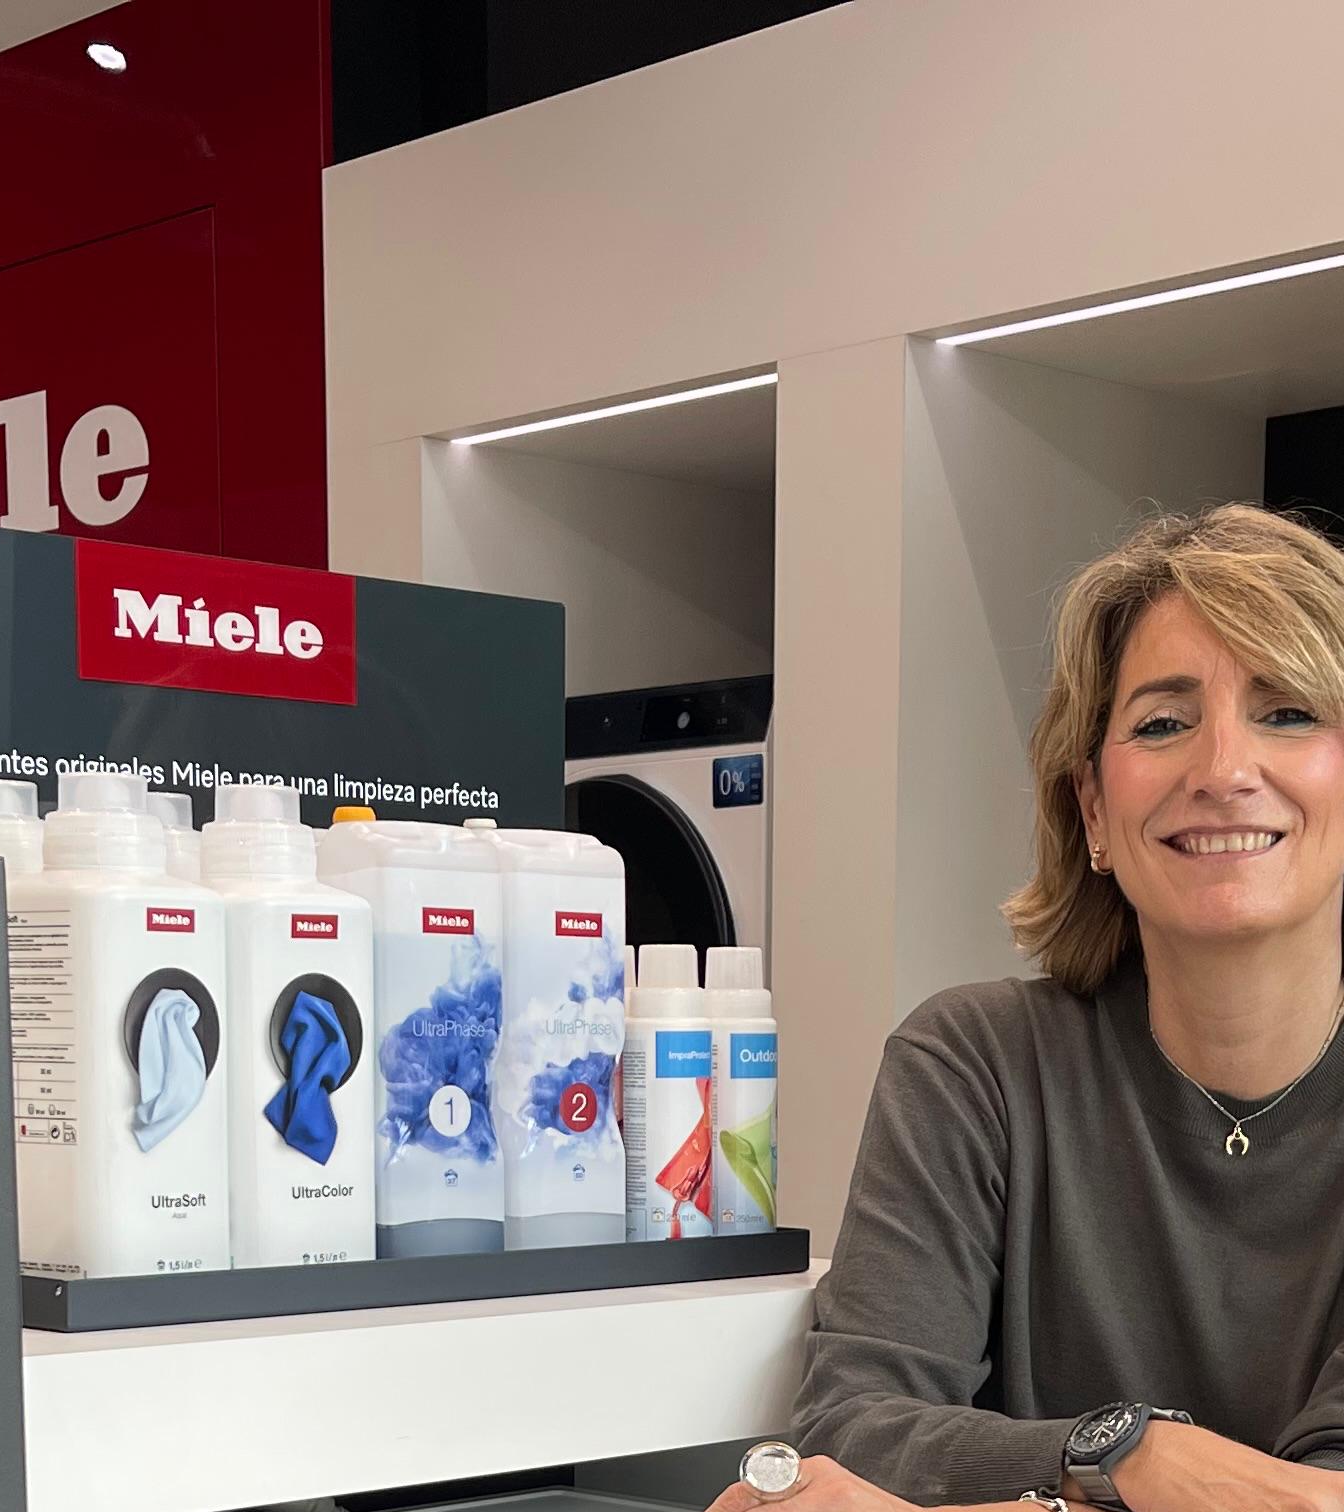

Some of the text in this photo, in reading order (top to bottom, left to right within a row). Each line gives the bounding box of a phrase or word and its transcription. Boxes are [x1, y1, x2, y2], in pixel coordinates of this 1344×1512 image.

[113, 587, 324, 660] Miele
[172, 760, 233, 788] Miele
[291, 776, 328, 797] una
[333, 773, 415, 805] limpieza
[420, 783, 500, 809] perfecta
[719, 768, 745, 795] 0%
[152, 913, 191, 926] Miele
[296, 921, 333, 933] Miele
[428, 915, 469, 928] Miele
[560, 918, 598, 931] Miele
[412, 1019, 486, 1038] UltraPhase
[545, 1019, 612, 1037] UltraPhase
[444, 1097, 455, 1126] 1
[571, 1092, 587, 1122] 2
[151, 1193, 206, 1209] UltraSoft
[291, 1184, 354, 1200] UltraColor
